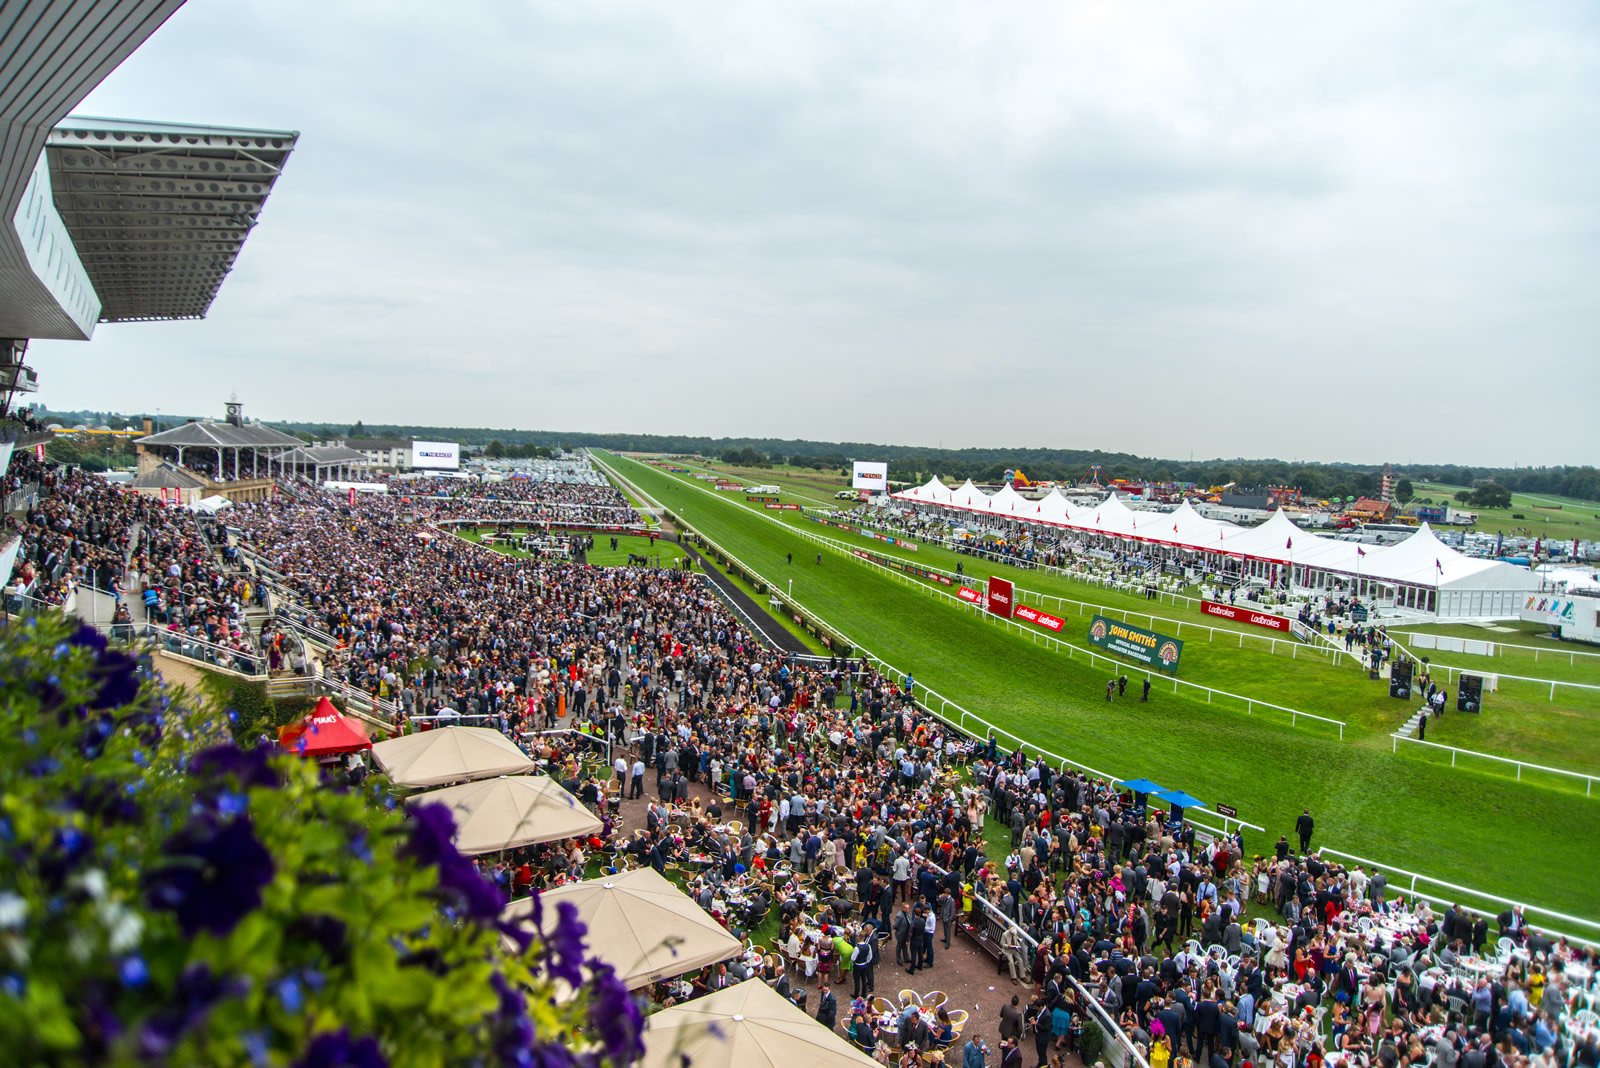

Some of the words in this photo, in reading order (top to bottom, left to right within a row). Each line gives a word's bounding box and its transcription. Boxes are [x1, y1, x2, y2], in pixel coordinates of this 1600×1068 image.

[991, 591, 1008, 604] Ladbrokes
[1016, 607, 1037, 620] Ladbrokes
[1038, 614, 1060, 628] Ladbrokes
[1208, 605, 1235, 618] Ladbrokes
[1251, 614, 1280, 628] Ladbrokes
[1109, 624, 1129, 639] JOHN
[1128, 630, 1157, 648] SMITH'S
